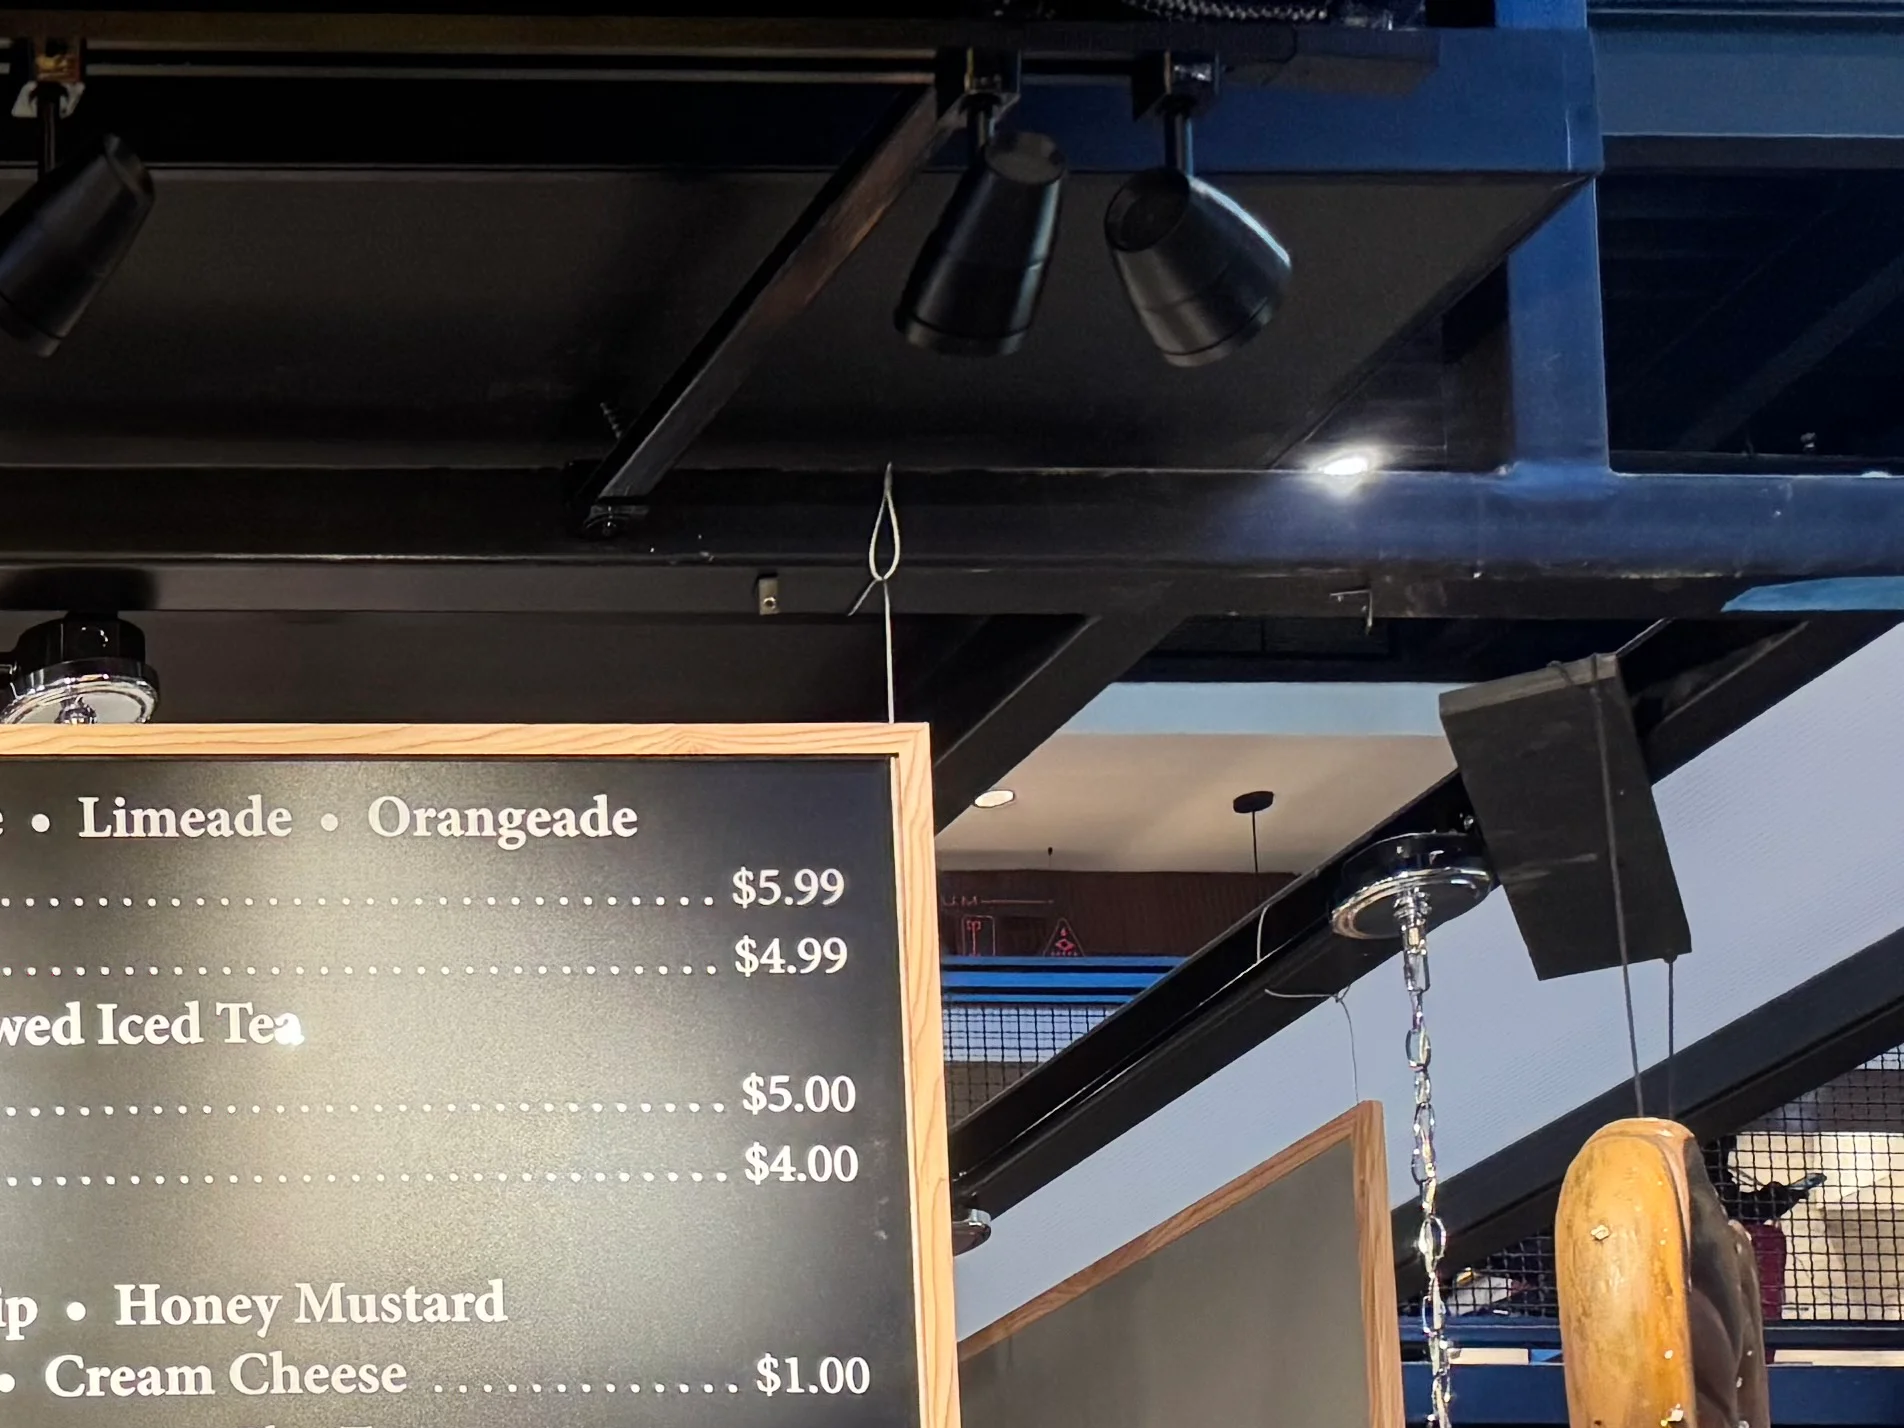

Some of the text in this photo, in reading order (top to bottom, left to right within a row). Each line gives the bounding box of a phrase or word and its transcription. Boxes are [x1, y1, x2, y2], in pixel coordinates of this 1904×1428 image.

[79, 794, 292, 837] Limeade
[369, 795, 637, 850] Orangeade
[733, 867, 844, 908] $5.99
[735, 935, 847, 977] $4.99
[97, 1001, 204, 1044] Iced
[216, 1003, 305, 1050] Tea
[743, 1073, 855, 1115] $5.00
[745, 1142, 858, 1185] $4.00
[115, 1284, 283, 1337] Honey
[295, 1279, 508, 1323] Mustard
[45, 1355, 215, 1397] Cream
[230, 1351, 406, 1394] Cheese
[757, 1353, 869, 1396] $1.00
